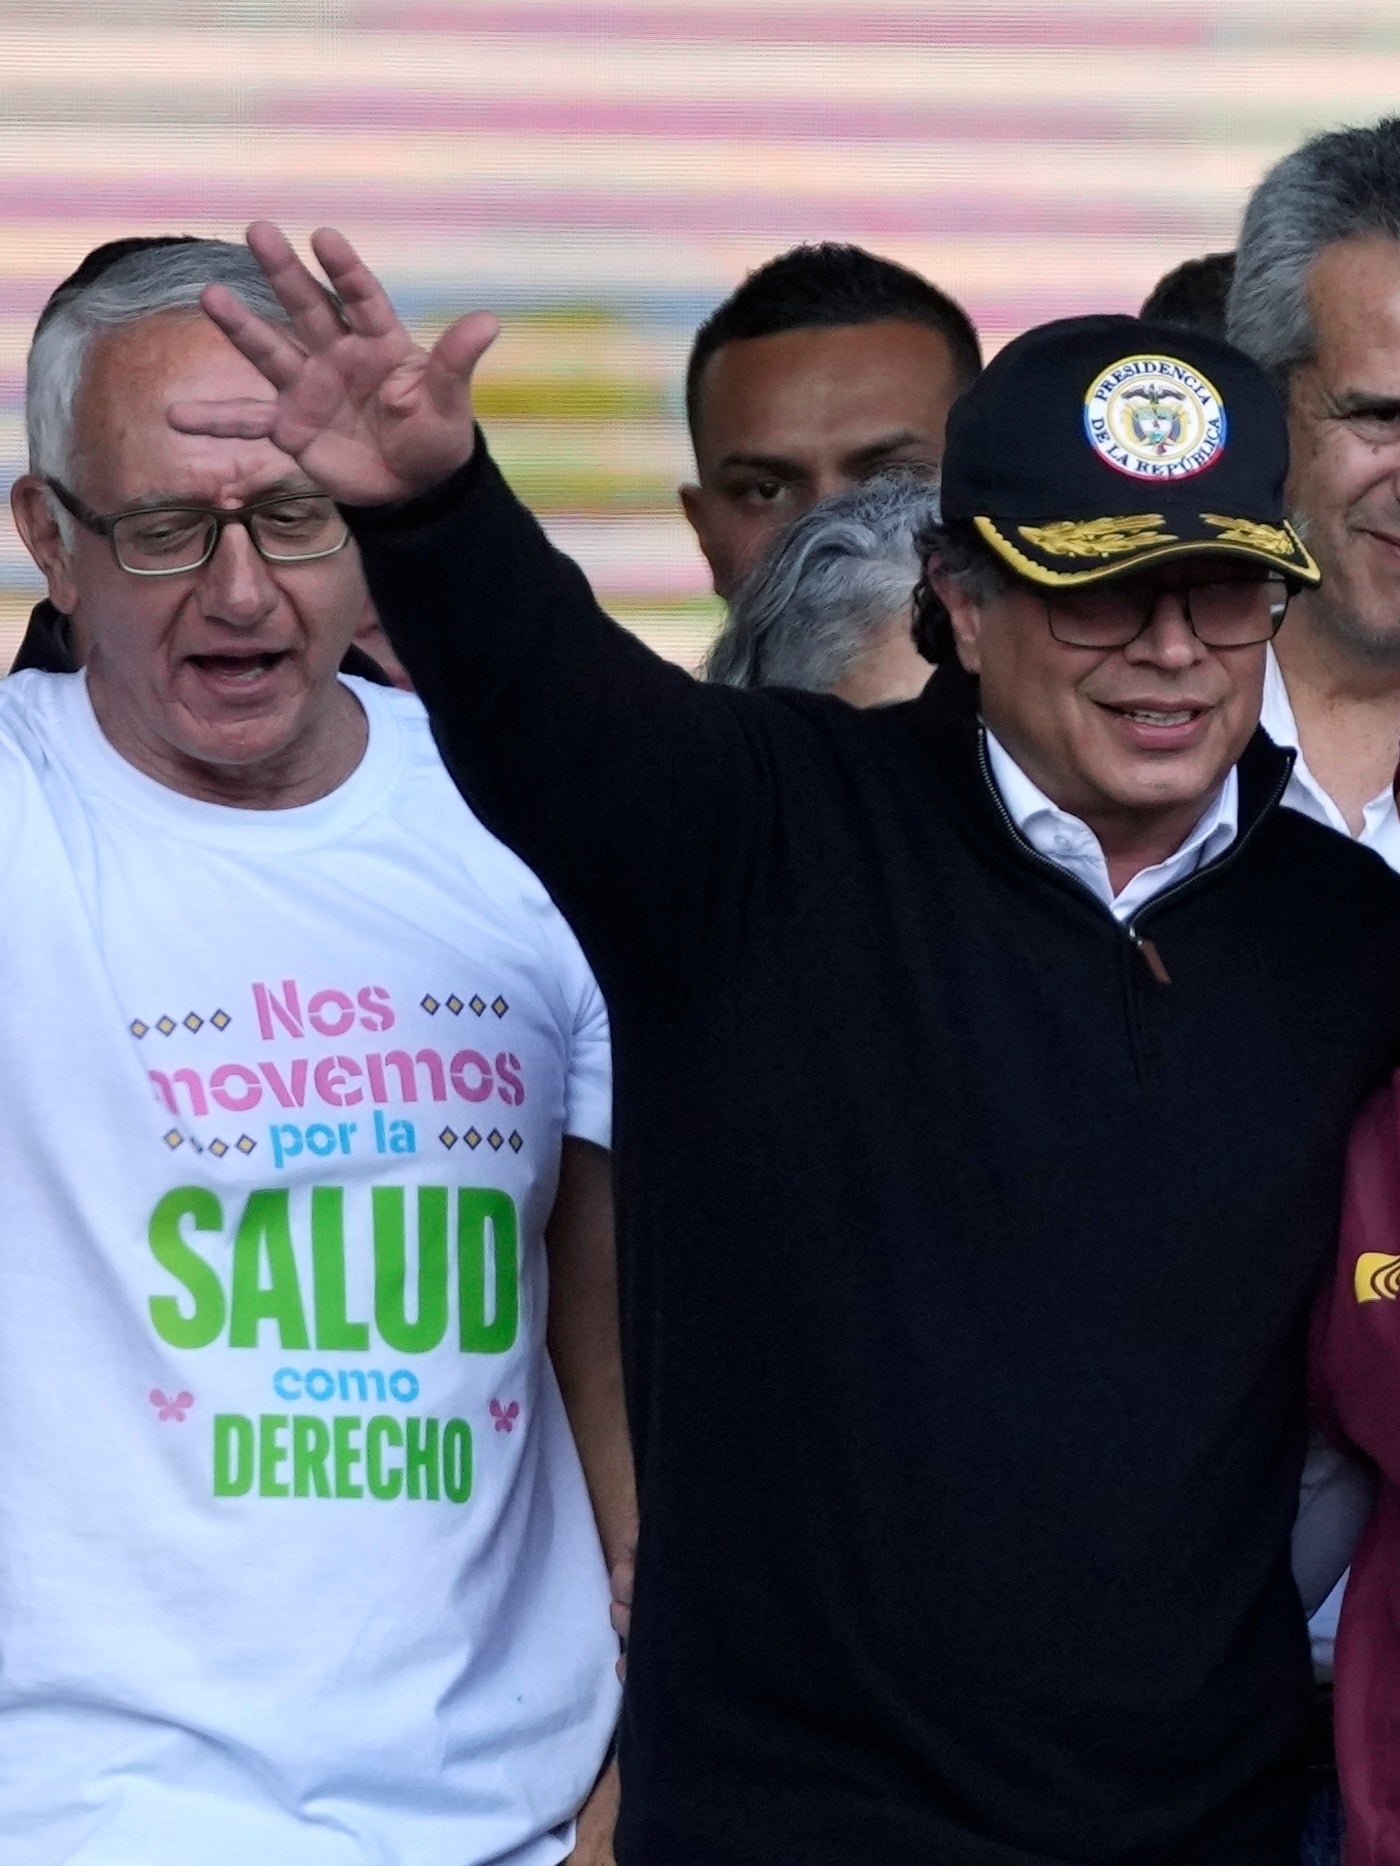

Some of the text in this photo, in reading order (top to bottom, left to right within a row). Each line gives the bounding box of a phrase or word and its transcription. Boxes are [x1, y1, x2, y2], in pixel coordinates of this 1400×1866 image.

[1094, 361, 1211, 405] PRESIDENCIA
[1091, 416, 1220, 476] DE LA REPÚBLICA
[252, 980, 396, 1040] Nos
[148, 1048, 526, 1116] movemos
[269, 1109, 416, 1169] por la
[148, 1184, 518, 1355] SALUD
[273, 1367, 420, 1404] como
[213, 1413, 473, 1504] DERECHO
